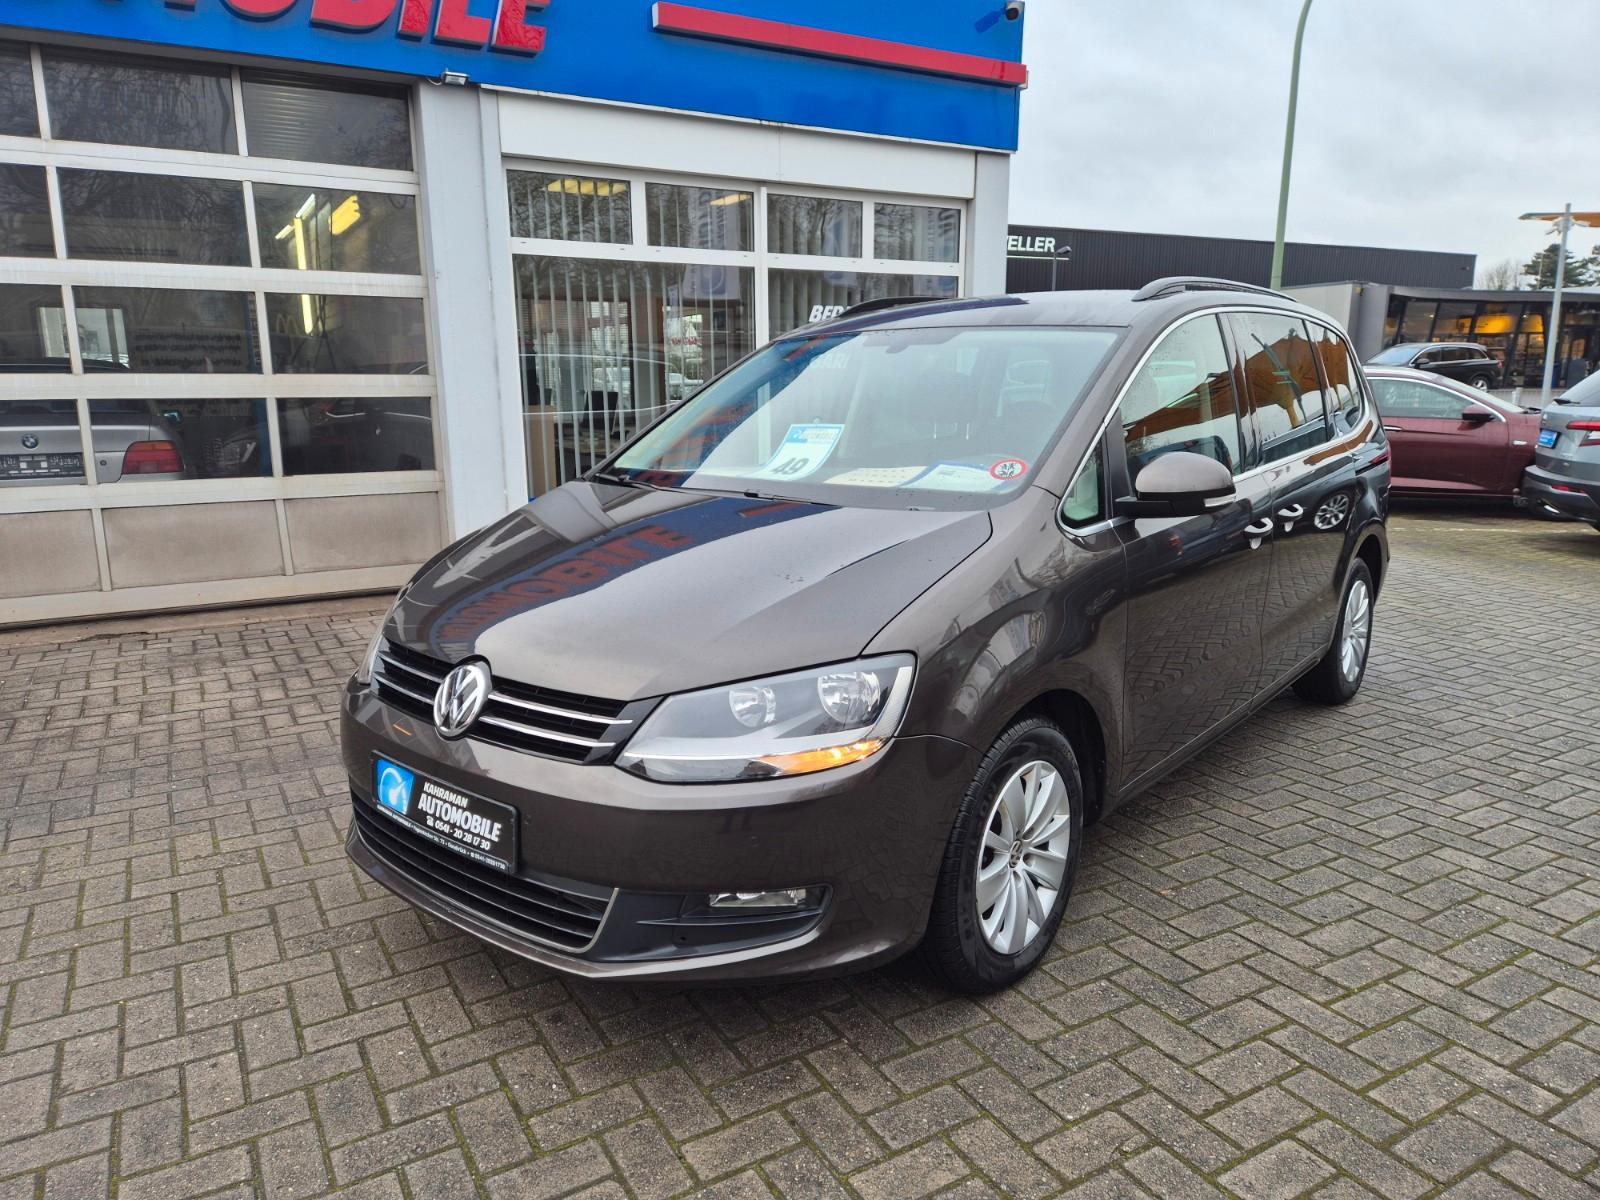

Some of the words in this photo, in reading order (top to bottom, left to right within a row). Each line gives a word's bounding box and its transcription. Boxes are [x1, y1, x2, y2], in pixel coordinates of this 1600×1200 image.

[1007, 235, 1056, 252] ELLER
[772, 457, 810, 475] 49
[424, 781, 468, 808] KAHRAMAN
[418, 793, 501, 842] AUTOMOBILE
[435, 820, 450, 833] 0541
[453, 828, 463, 839] 20
[463, 832, 473, 843] 28
[473, 836, 480, 846] 17
[480, 839, 490, 850] 30
